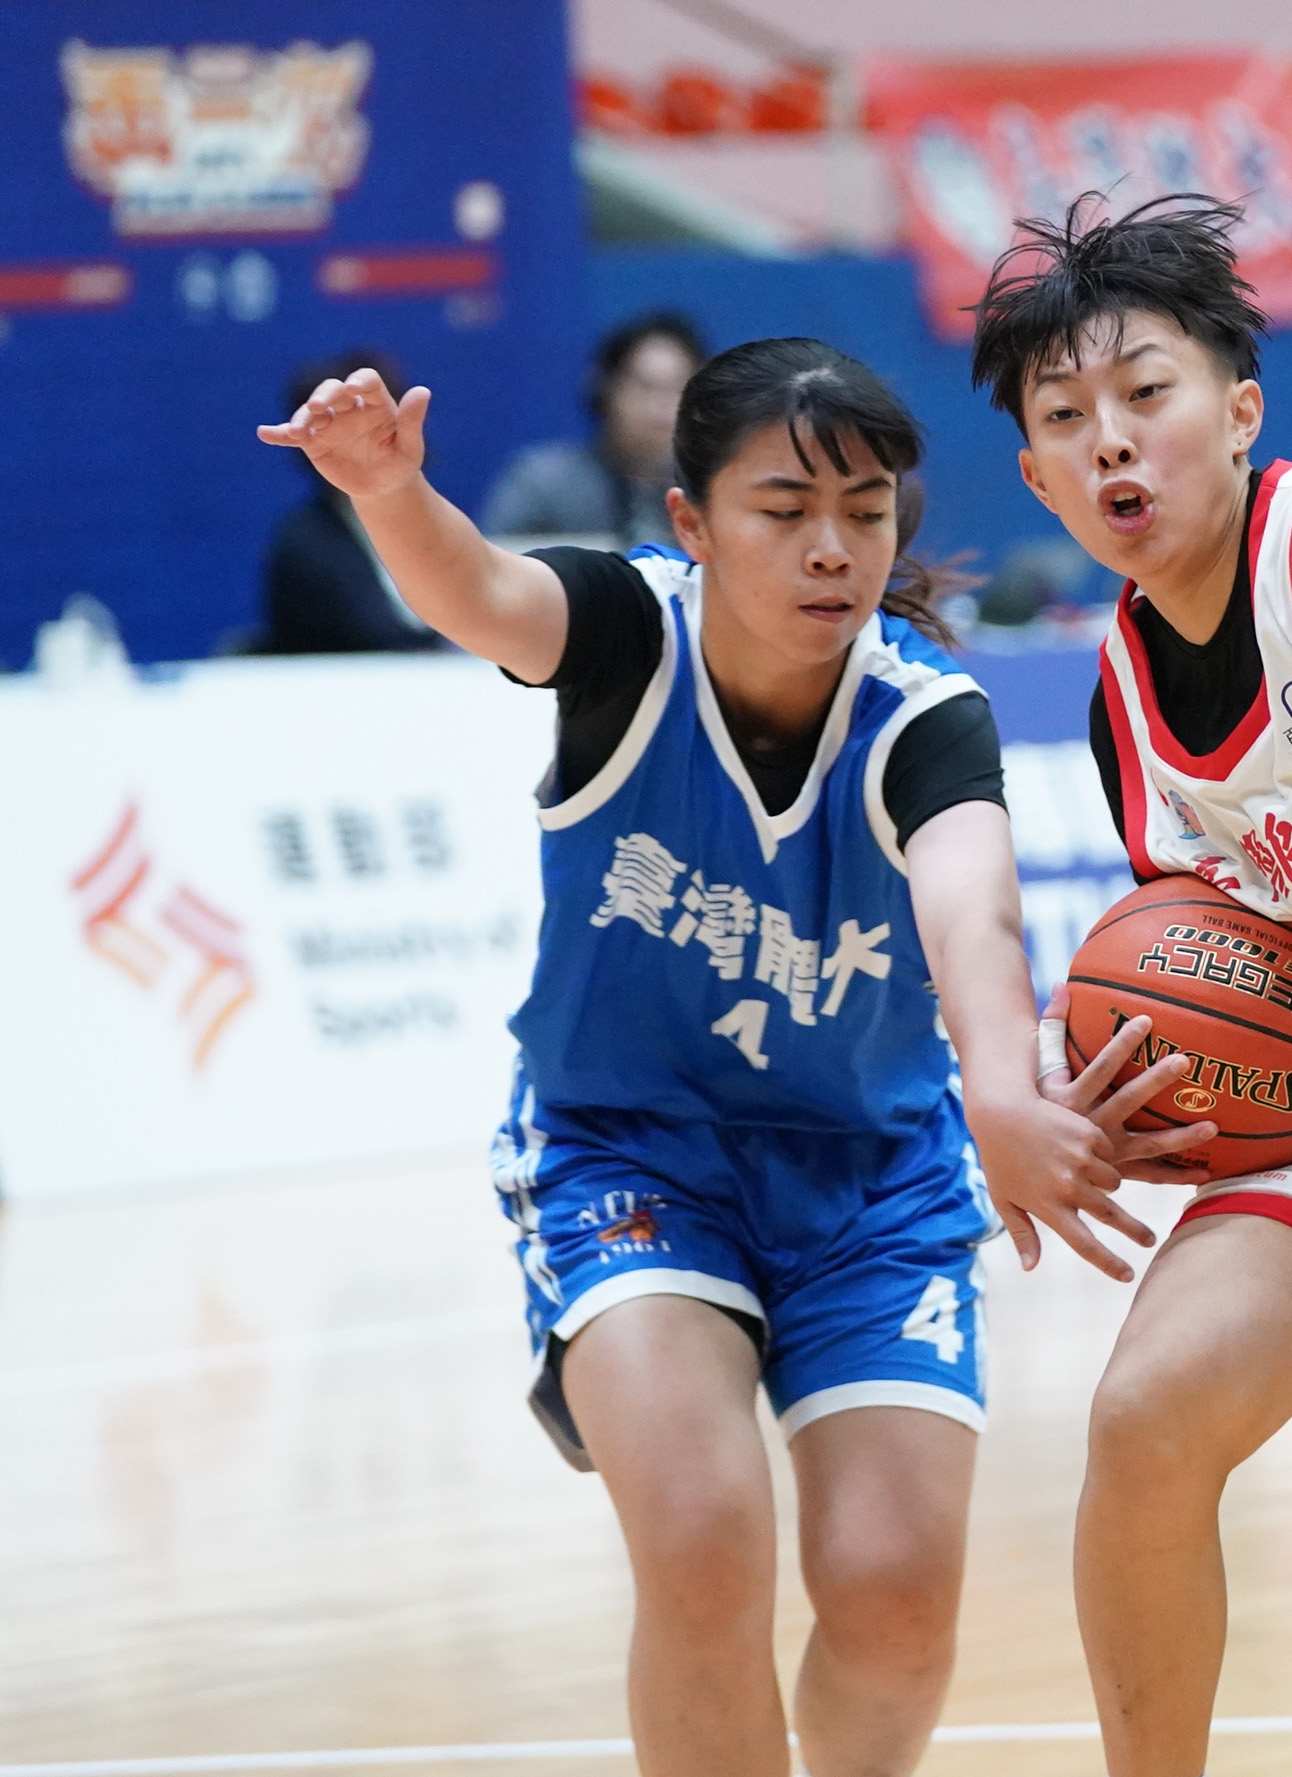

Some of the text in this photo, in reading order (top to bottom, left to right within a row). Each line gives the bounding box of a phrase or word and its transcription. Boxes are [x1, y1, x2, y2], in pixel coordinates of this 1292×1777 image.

[1202, 914, 1225, 928] BALL
[1227, 919, 1252, 935] GAME
[901, 1274, 965, 1365] 4
